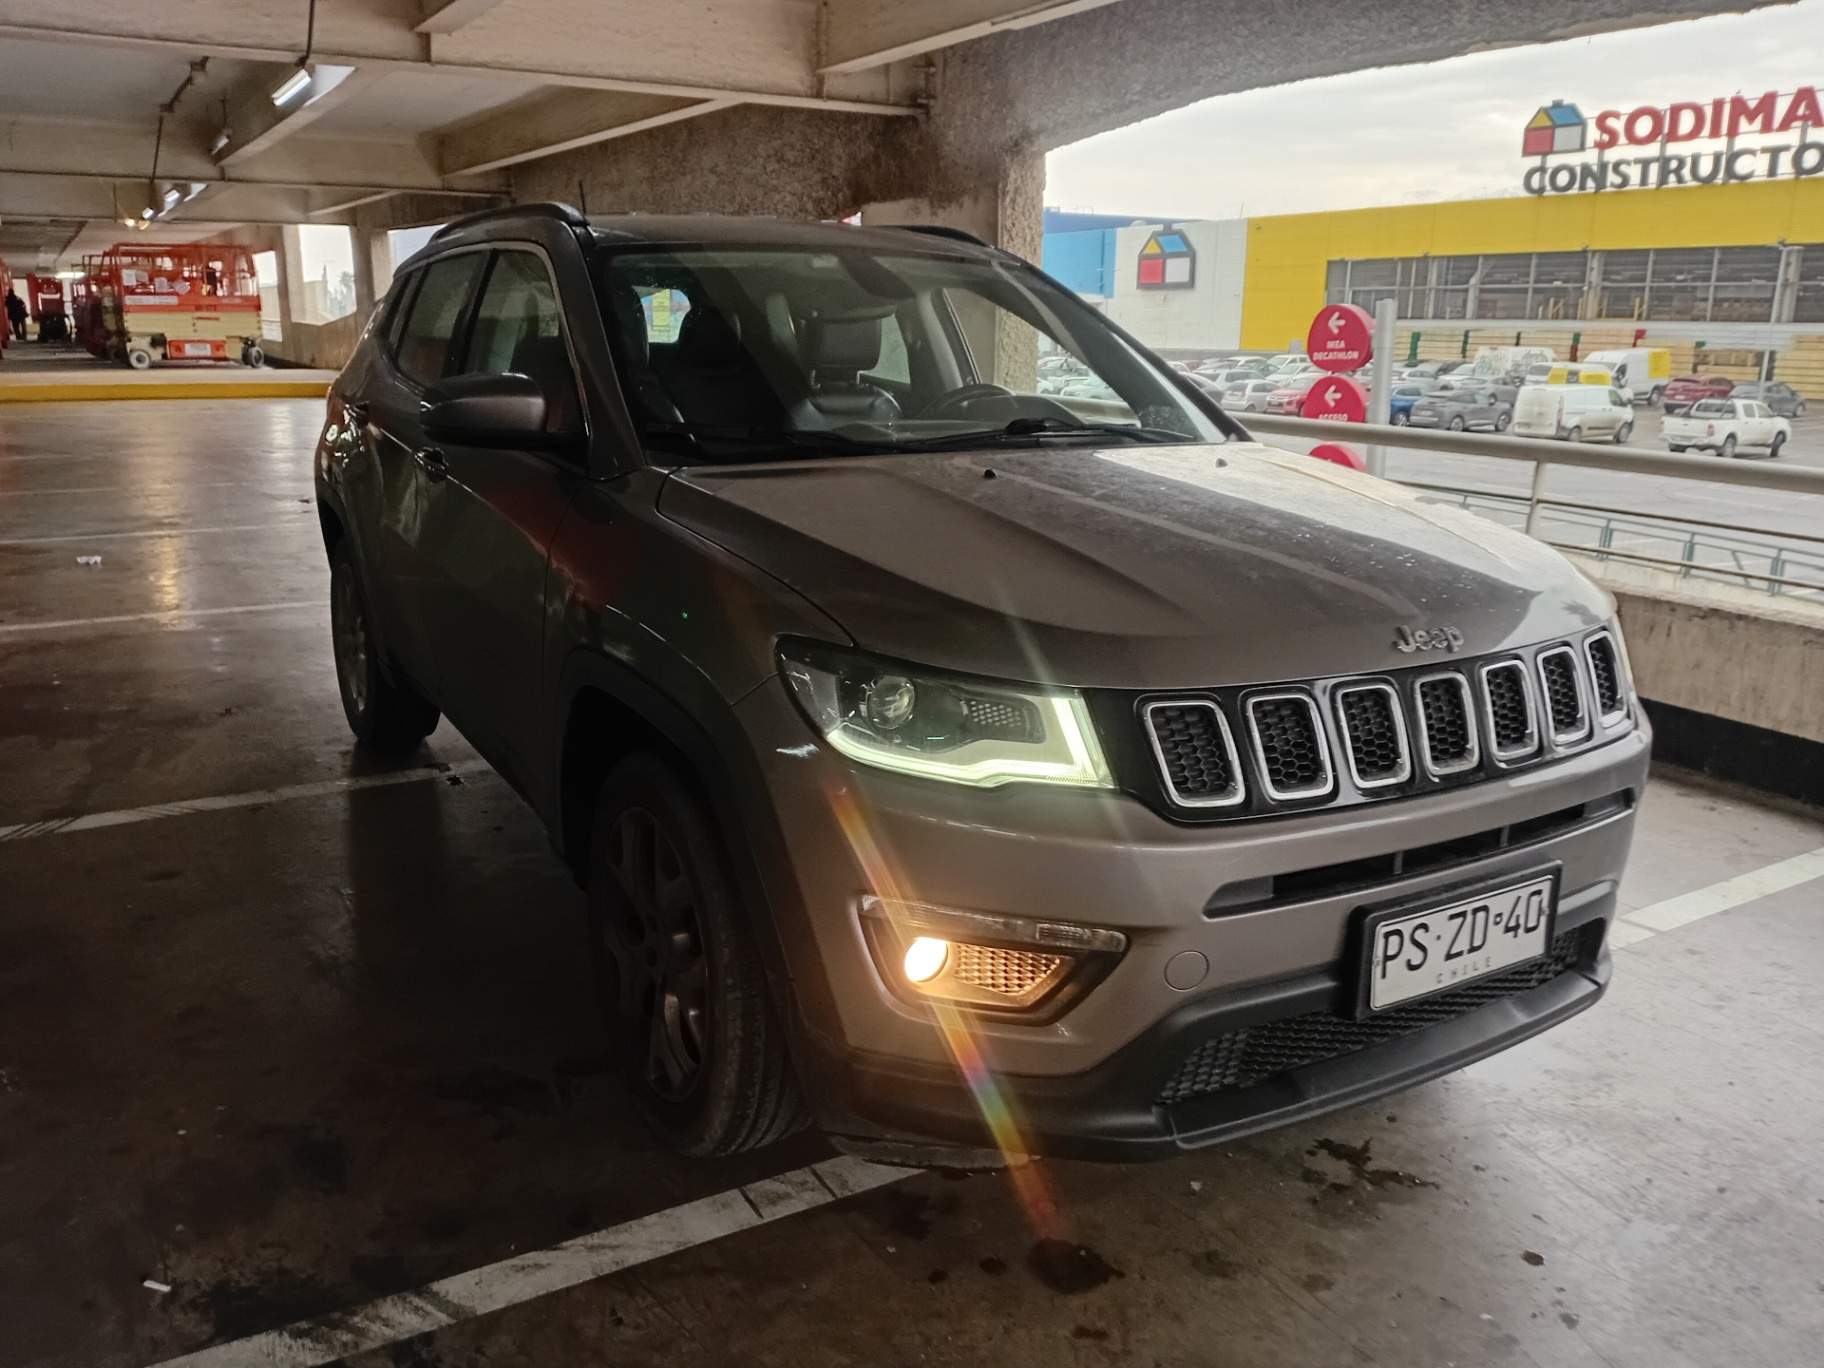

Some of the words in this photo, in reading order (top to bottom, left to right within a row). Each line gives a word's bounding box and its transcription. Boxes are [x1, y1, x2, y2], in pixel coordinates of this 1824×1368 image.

[1593, 86, 1824, 150] SODIMA
[1523, 141, 1824, 195] CONSTRUCTO
[1312, 351, 1359, 360] DECATHLON
[1326, 340, 1345, 349] IKEA
[1395, 624, 1464, 653] Jeep
